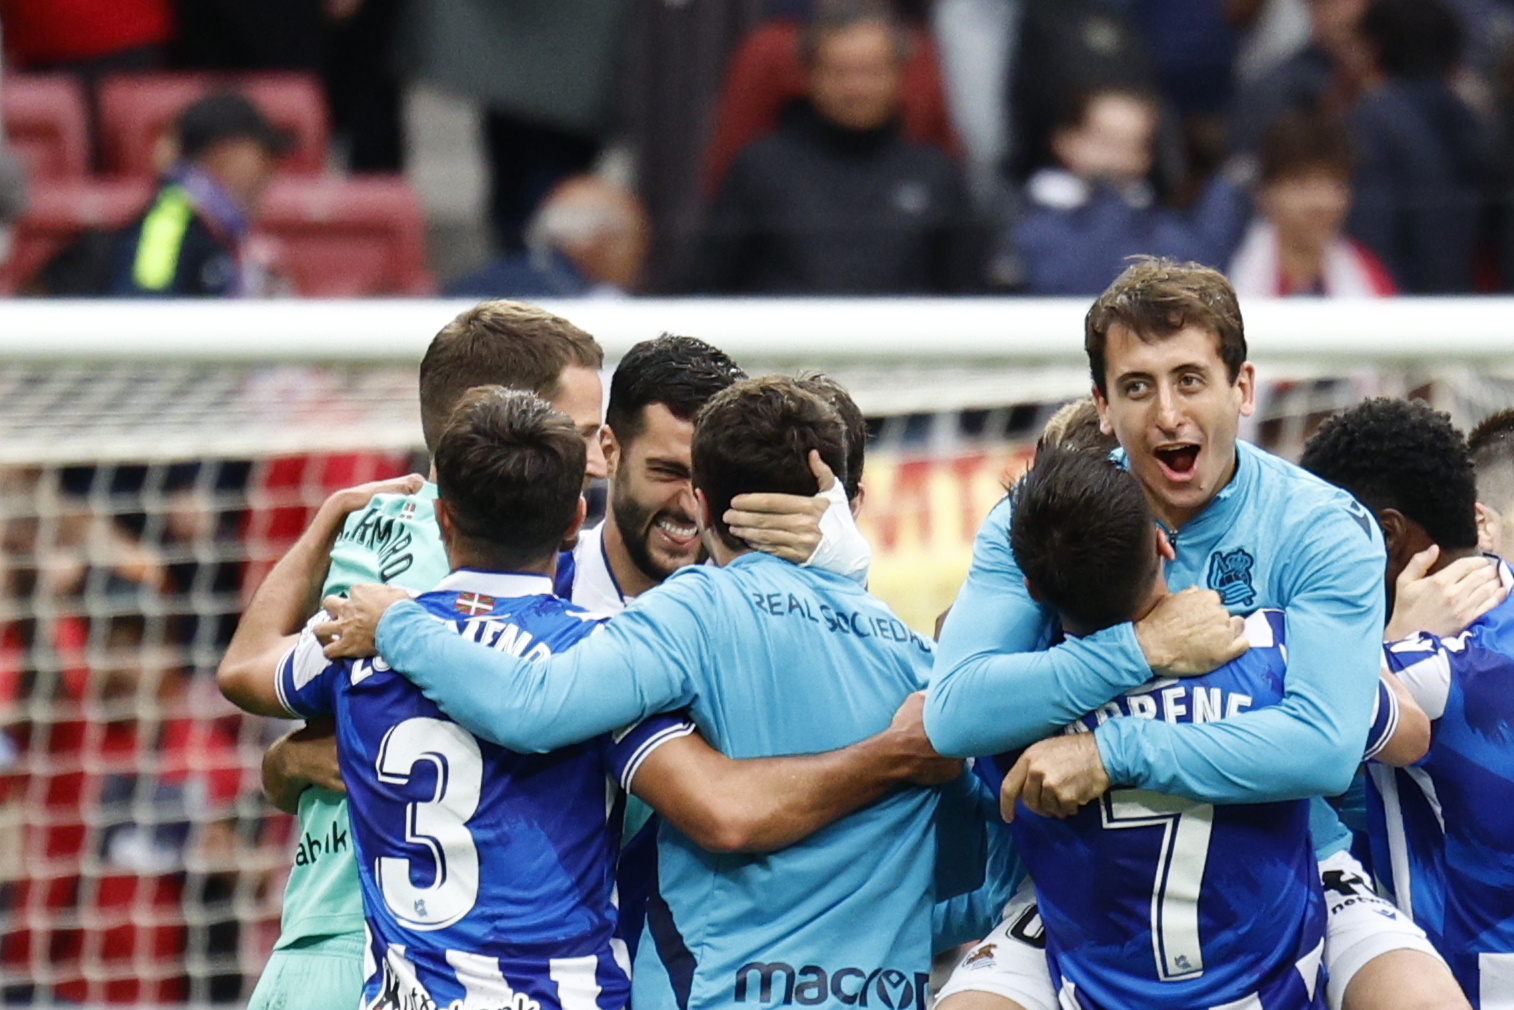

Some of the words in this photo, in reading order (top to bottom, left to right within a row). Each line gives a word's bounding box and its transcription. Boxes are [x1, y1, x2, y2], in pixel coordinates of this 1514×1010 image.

[752, 592, 819, 624] REAL
[375, 717, 484, 932] 3
[1099, 788, 1214, 982] 7
